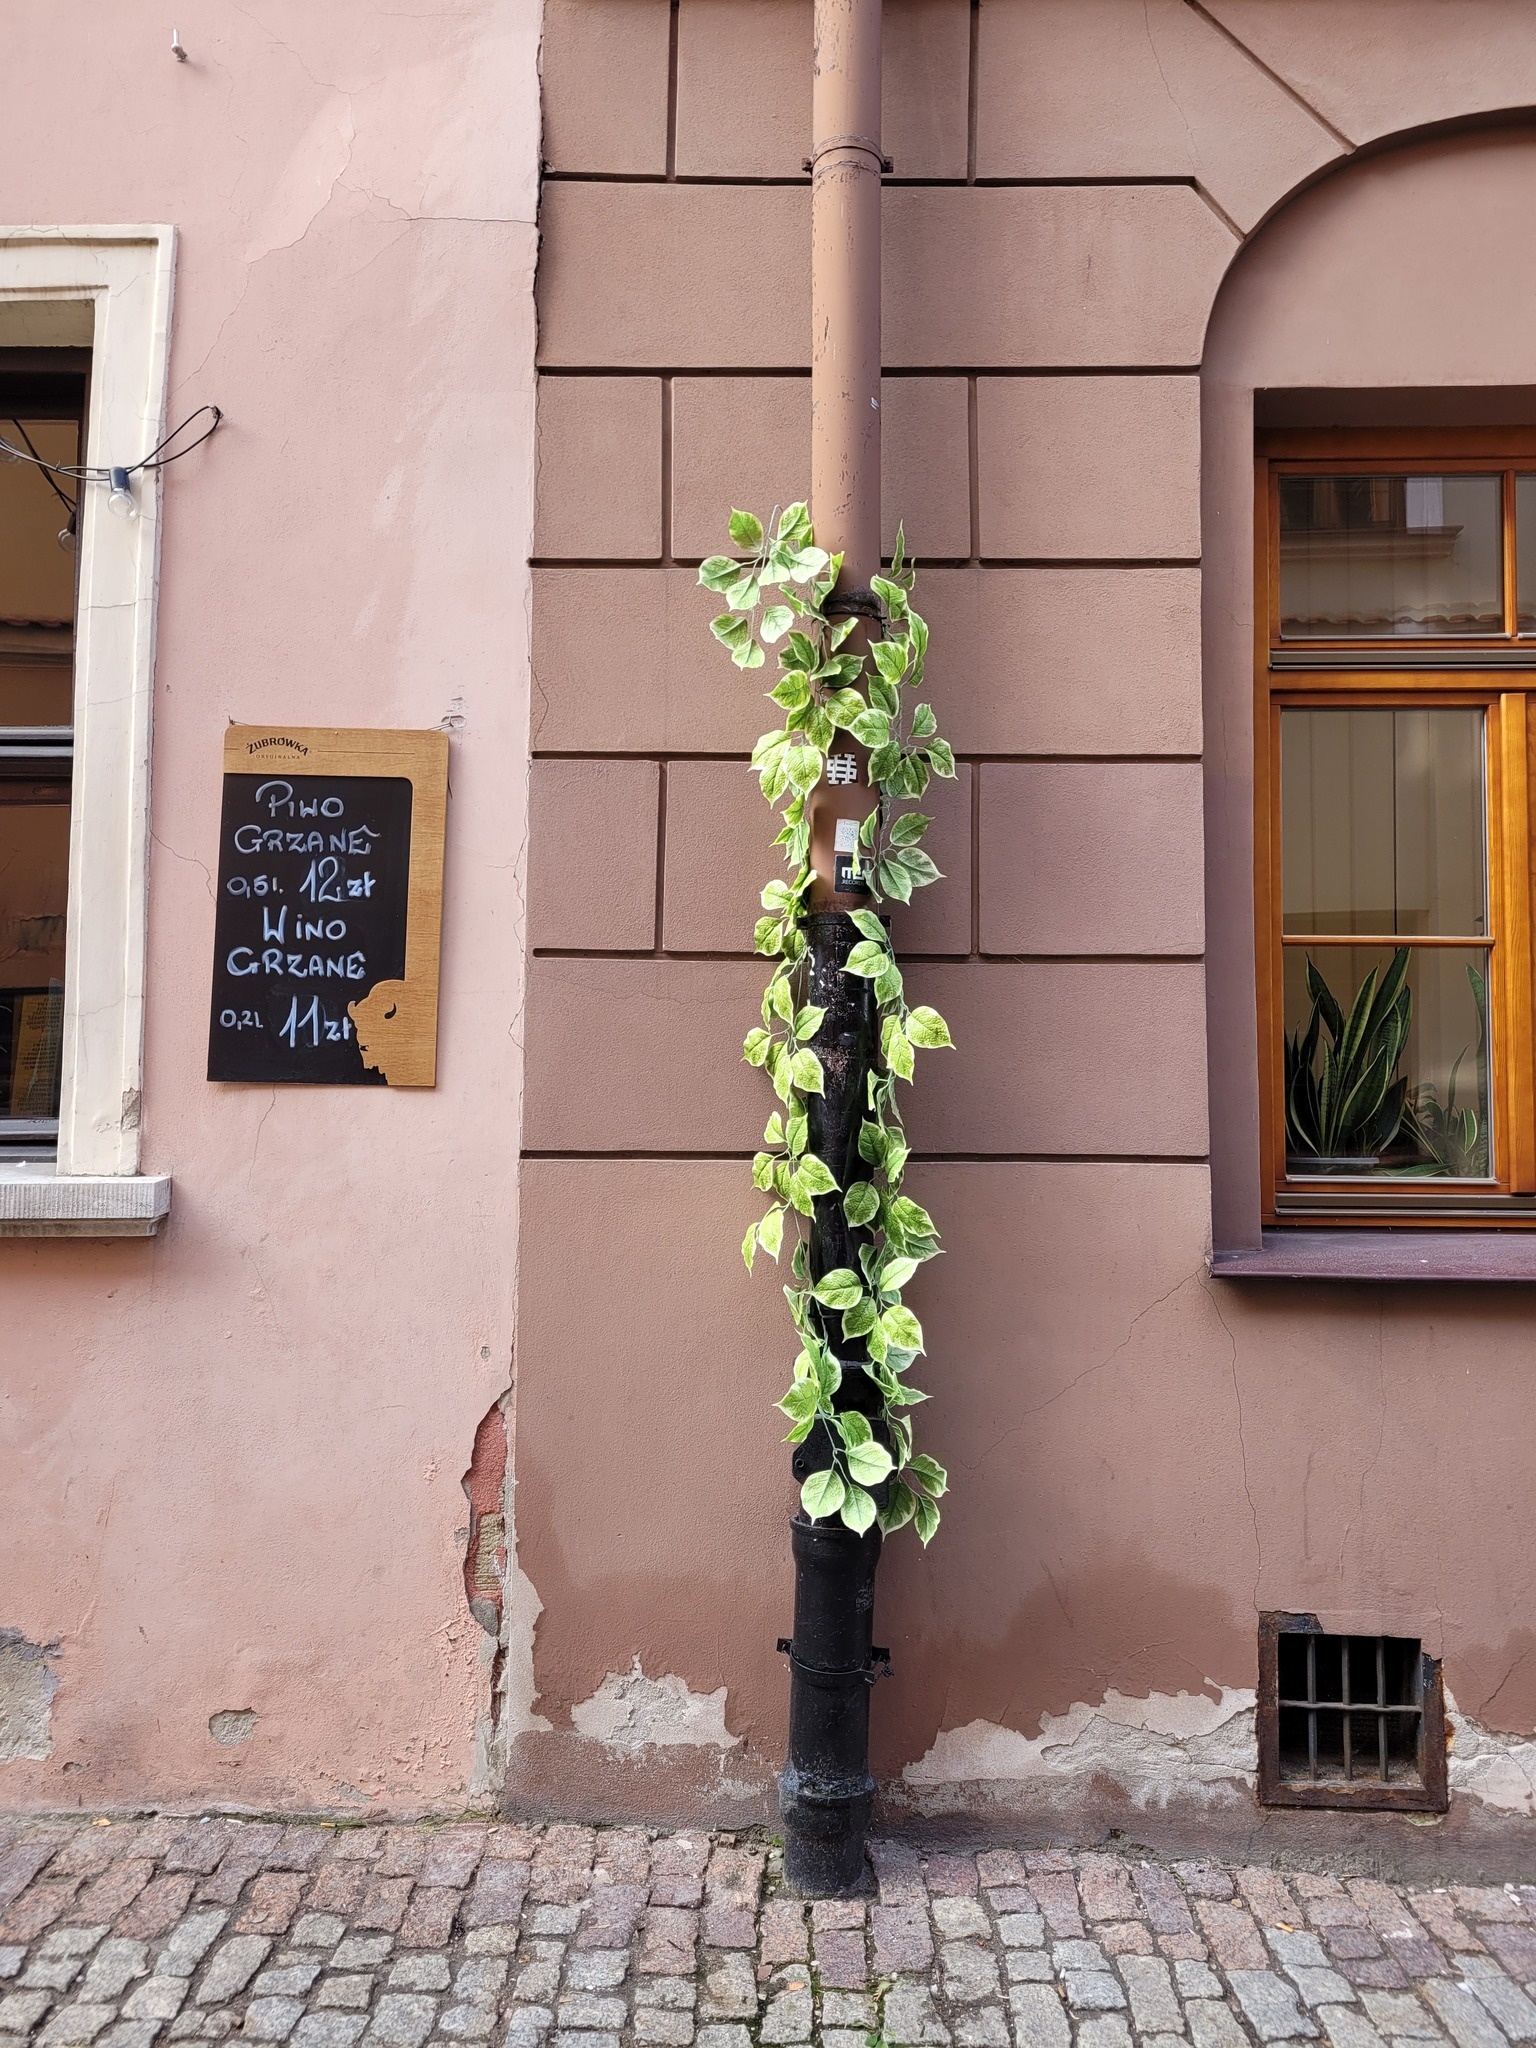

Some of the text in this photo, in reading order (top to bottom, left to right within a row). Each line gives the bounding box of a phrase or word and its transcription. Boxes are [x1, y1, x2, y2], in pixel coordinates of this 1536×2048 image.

[245, 737, 309, 756] ŻUBRÓWKA
[234, 824, 382, 855] GRZANE
[226, 946, 367, 980] GRZANE
